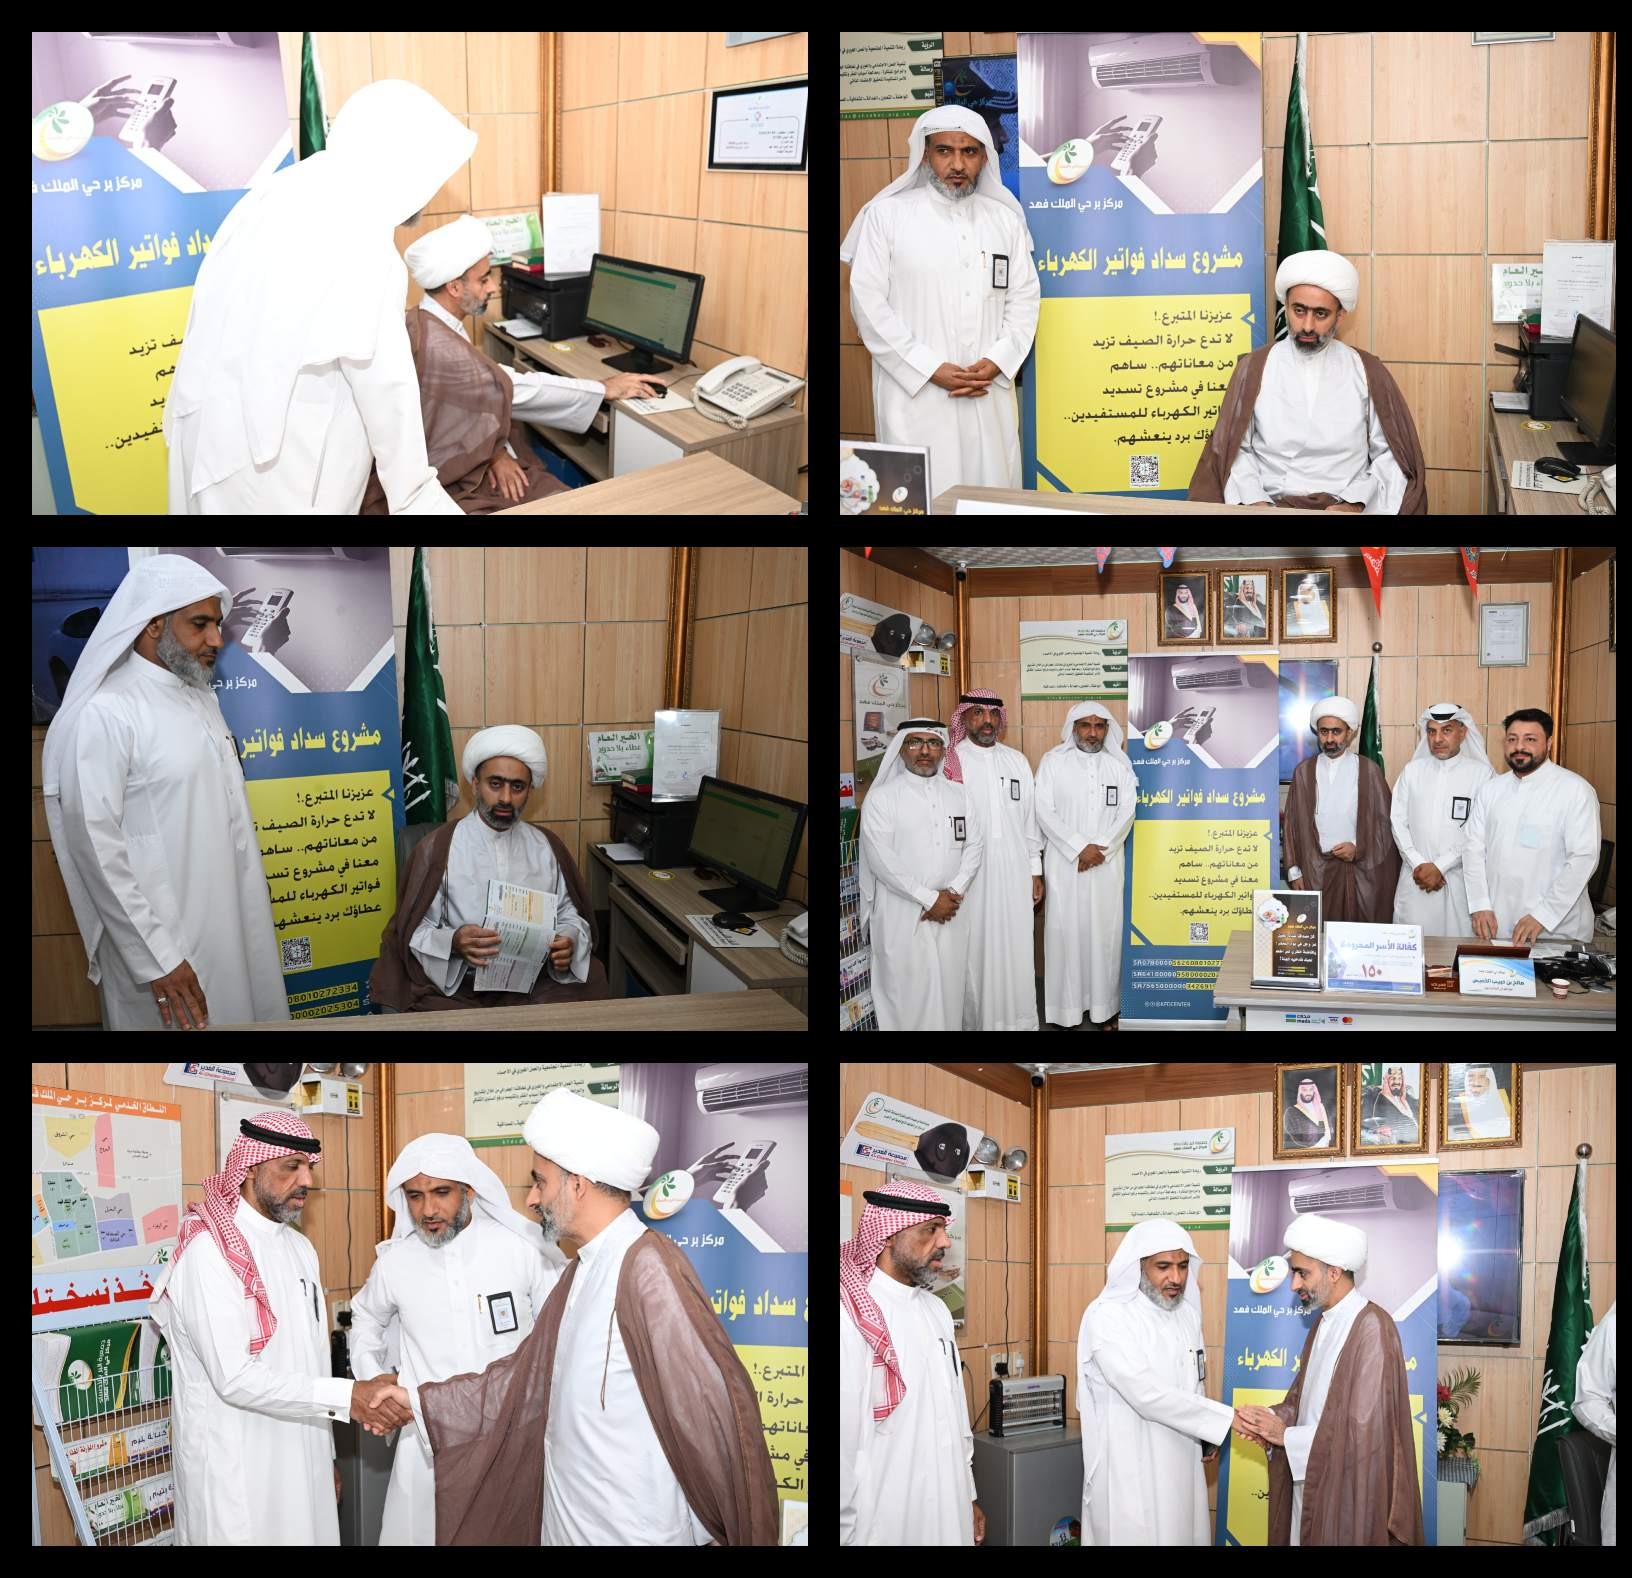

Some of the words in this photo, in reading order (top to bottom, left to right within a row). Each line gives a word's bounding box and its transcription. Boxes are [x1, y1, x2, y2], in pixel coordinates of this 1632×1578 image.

[41, 177, 79, 194] الملك
[81, 179, 100, 196] حي
[103, 179, 112, 192] بر
[115, 175, 143, 190] مركز
[1028, 198, 1049, 210] فهد
[1051, 197, 1076, 209] الملك
[1077, 199, 1092, 213] حي
[1093, 199, 1101, 210] بر
[1102, 197, 1124, 209] مركز
[186, 228, 212, 257] داد
[128, 231, 181, 270] فواتير
[34, 237, 120, 280] الكهرباء
[1038, 248, 1098, 277] الكهرباء
[1103, 246, 1146, 276] فواتير
[1151, 246, 1186, 272] سداد
[1192, 245, 1244, 275] مشروع
[1200, 310, 1233, 323] عزيزنا
[1092, 336, 1116, 350] تزيد
[1119, 334, 1163, 349] الصيف
[1166, 335, 1196, 349] حرارة
[1200, 335, 1222, 350] تدع
[1224, 333, 1233, 344] لا
[128, 338, 157, 356] تزيد
[1110, 360, 1147, 374] ساهم
[1217, 359, 1234, 372] من
[1102, 384, 1142, 395] تسديد
[1145, 382, 1188, 398] مشروع
[1191, 384, 1204, 400] في
[1207, 382, 1228, 392] عنا
[1151, 406, 1200, 420] الكهرباء
[1203, 406, 1221, 418] اتير
[1175, 433, 1190, 444] برد
[225, 678, 233, 690] بر
[235, 676, 257, 690] مركز
[240, 728, 285, 759] فواتير
[291, 726, 326, 750] سداد
[331, 722, 382, 753] مشروع
[342, 787, 374, 800] عزيزنا
[1136, 789, 1173, 808] الكهرباء
[1176, 788, 1203, 807] فواتير
[1207, 788, 1230, 804] سداد
[1232, 788, 1266, 807] مشروع
[310, 814, 340, 829] حرارة
[344, 812, 365, 828] تدع
[367, 809, 376, 820] لا
[262, 816, 308, 832] الصيف
[361, 835, 377, 847] من
[293, 861, 335, 881] مشروع
[337, 859, 350, 876] في
[353, 858, 379, 870] معنا
[299, 883, 347, 902] الكهرباء
[350, 877, 381, 896] فواتير
[324, 910, 340, 923] برد
[343, 902, 382, 917] عطاؤك
[274, 911, 322, 931] ينعشه
[1397, 943, 1417, 951] كفالة
[1362, 963, 1382, 978] ١٥٠
[57, 1094, 71, 1104] حي
[75, 1094, 86, 1106] بر
[114, 1100, 142, 1112] الخدمي
[142, 1104, 167, 1114] النطاق
[691, 1235, 699, 1248] بر
[701, 1234, 725, 1246] مركز
[754, 1289, 796, 1316] سداد
[1233, 1305, 1250, 1314] فهد
[1251, 1304, 1272, 1314] الملك
[1273, 1306, 1284, 1318] حي
[1286, 1306, 1293, 1315] بر
[1237, 1346, 1288, 1371] الكهرباء
[767, 1391, 803, 1408] حرارة
